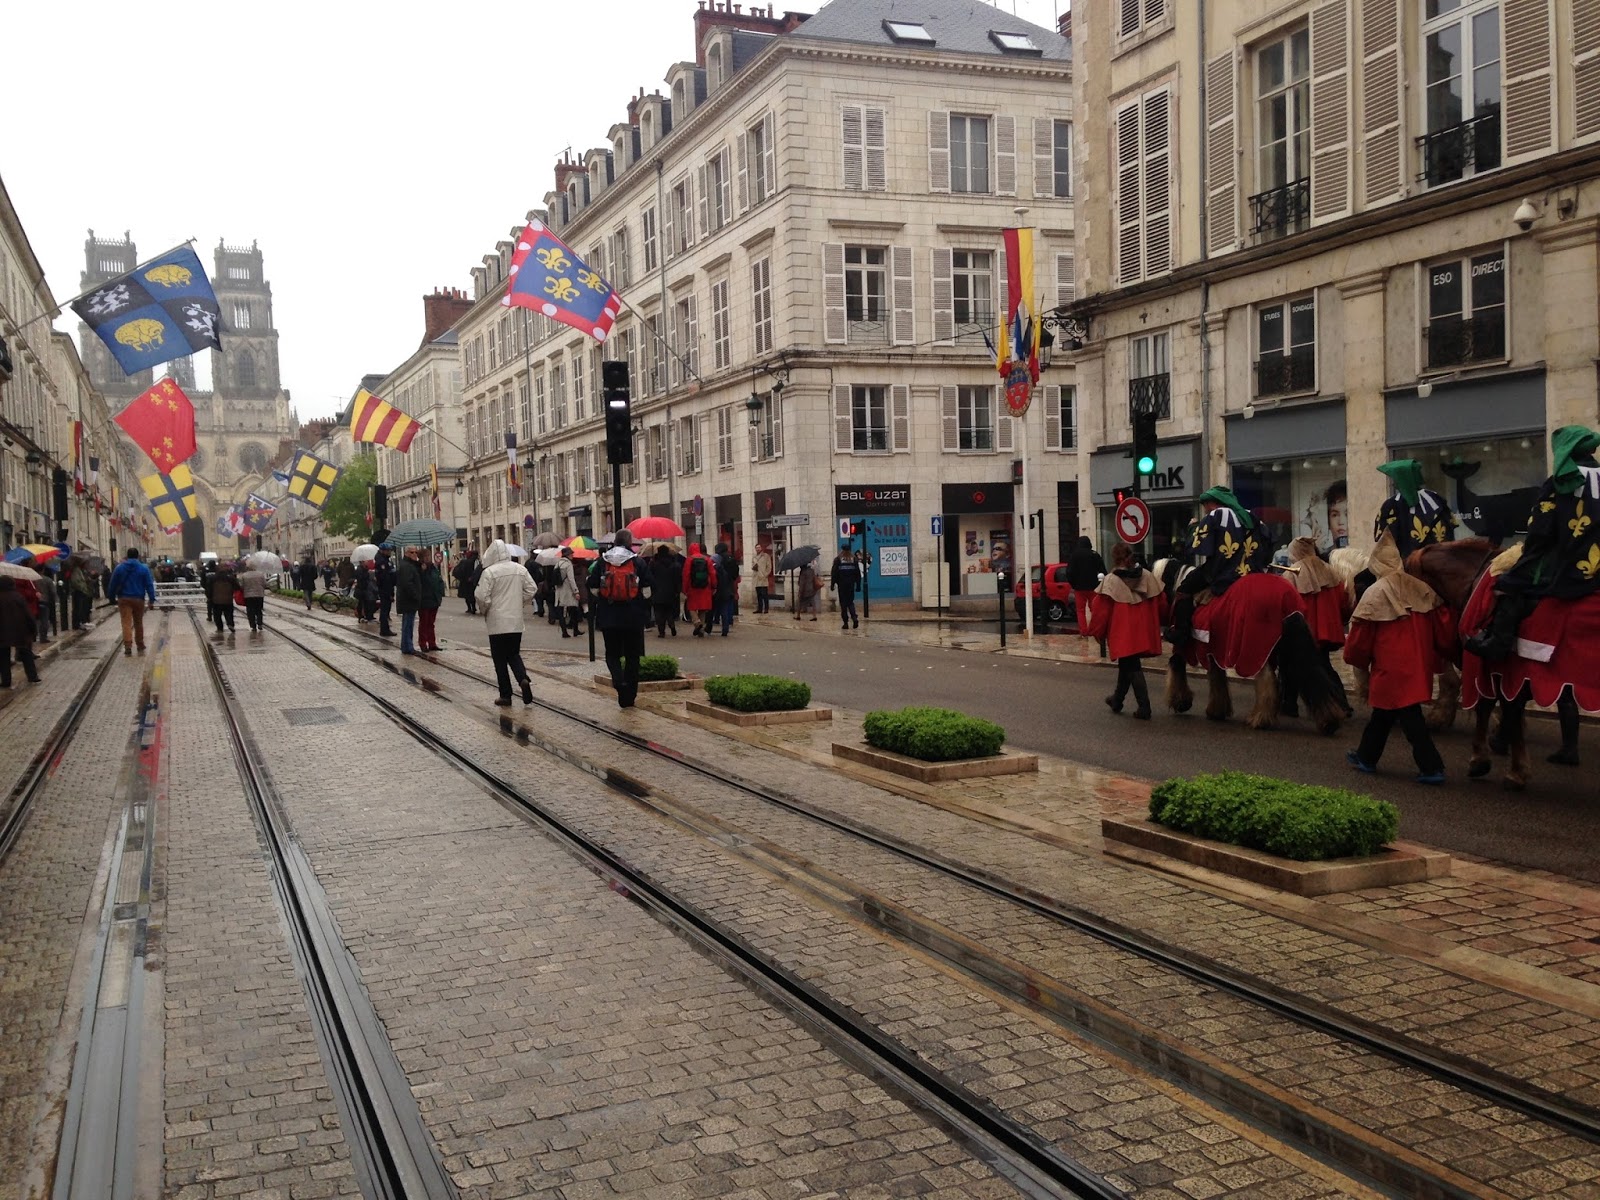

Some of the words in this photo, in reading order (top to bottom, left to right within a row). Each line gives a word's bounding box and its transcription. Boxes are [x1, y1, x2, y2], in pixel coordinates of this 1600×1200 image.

[1433, 272, 1452, 286] ESO
[1472, 258, 1505, 278] DIRECT
[881, 553, 908, 562] -20%
